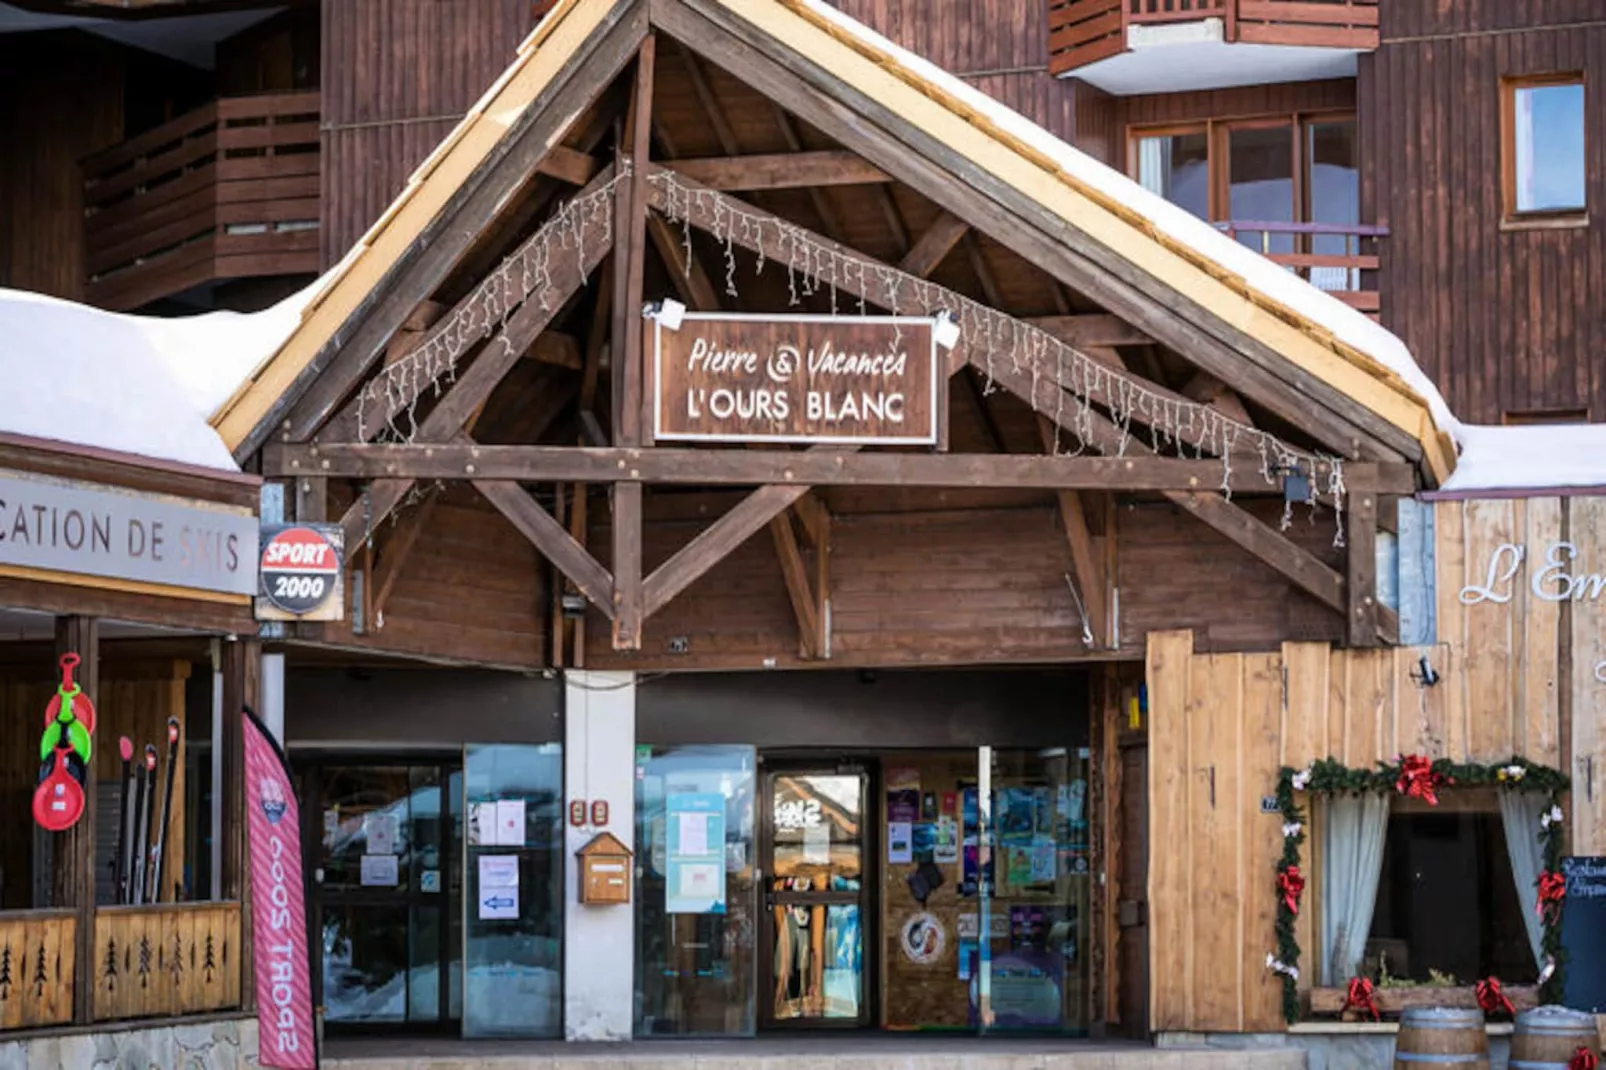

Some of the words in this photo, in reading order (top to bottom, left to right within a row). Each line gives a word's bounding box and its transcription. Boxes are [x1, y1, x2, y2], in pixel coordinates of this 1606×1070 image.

[687, 337, 758, 375] Pierre
[807, 340, 907, 377] Vacances
[686, 388, 790, 420] L'OURS
[806, 391, 905, 423] BLANC
[128, 518, 165, 563] DE
[179, 524, 239, 574] SKIS
[265, 541, 329, 565] SPORT
[274, 576, 325, 599] 2000
